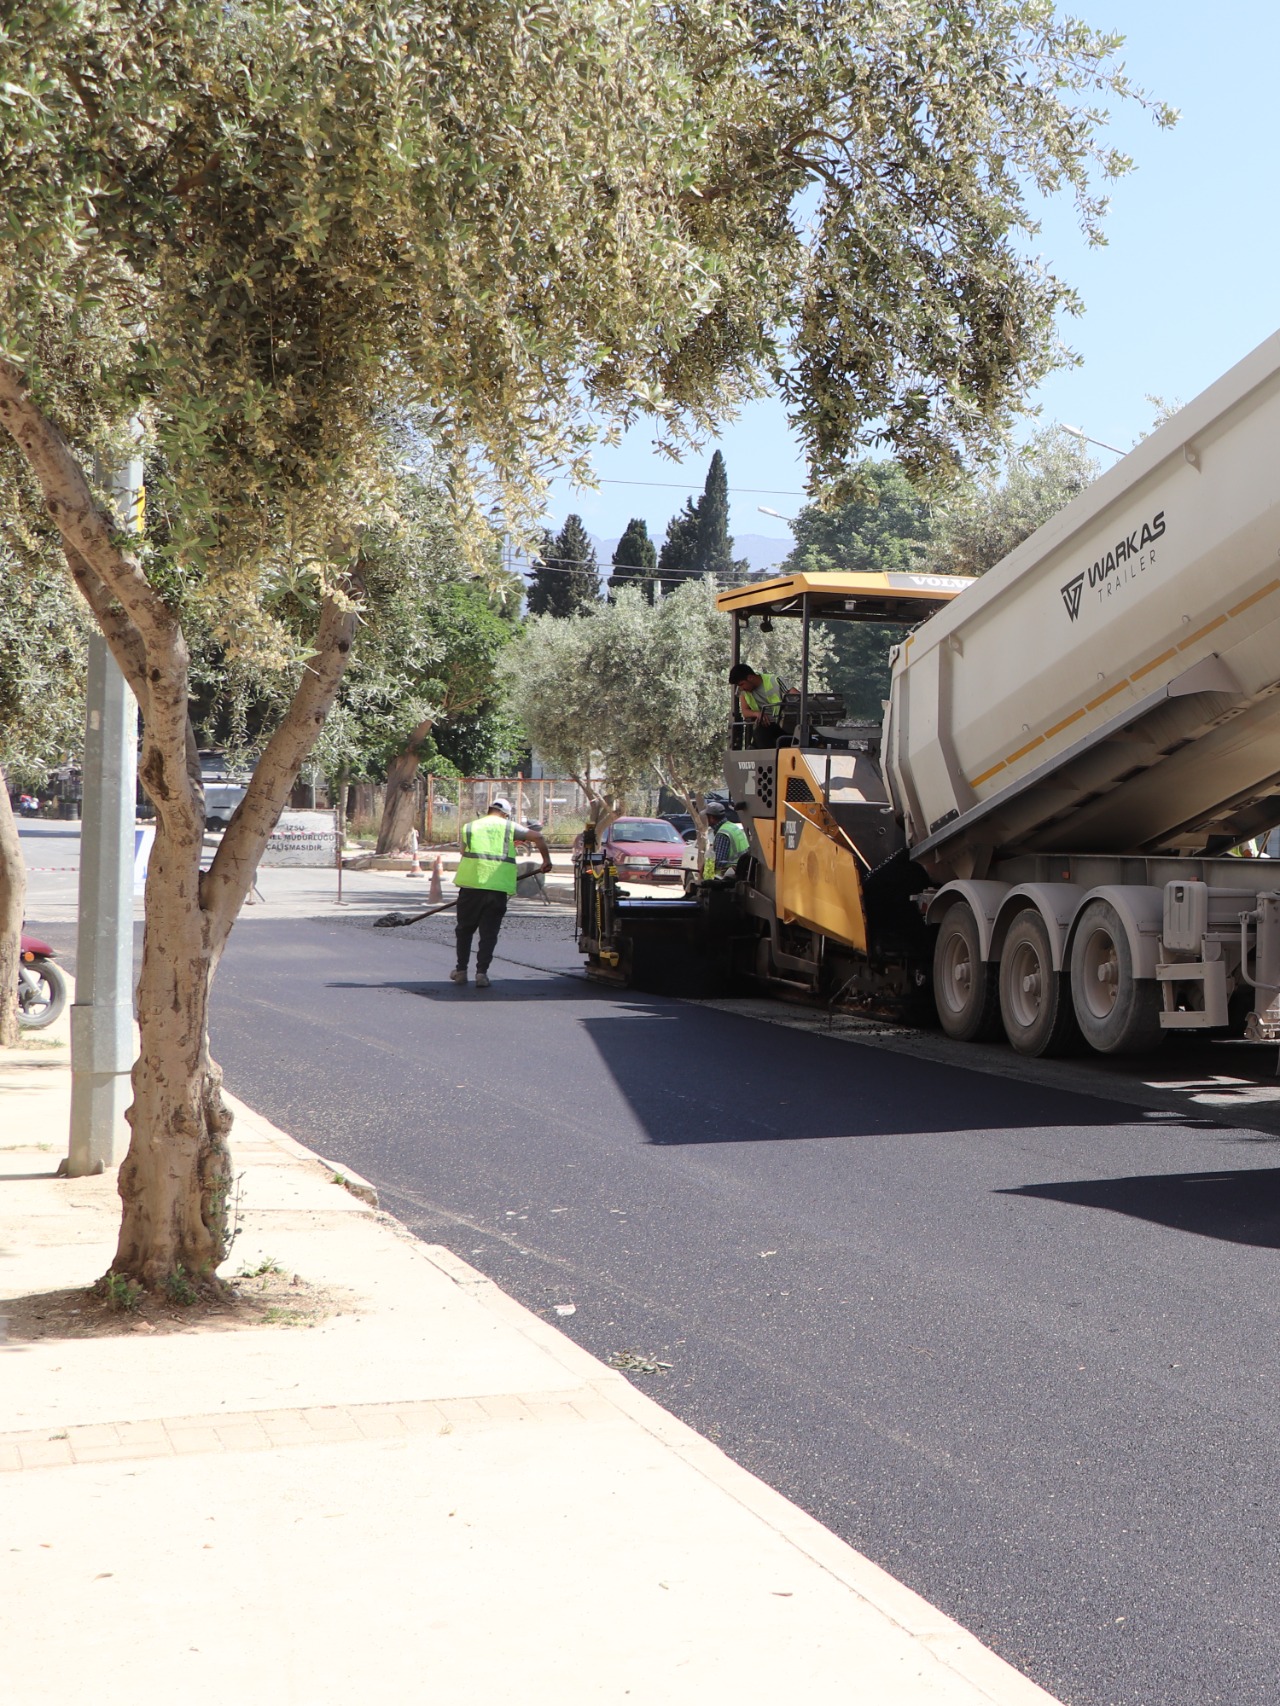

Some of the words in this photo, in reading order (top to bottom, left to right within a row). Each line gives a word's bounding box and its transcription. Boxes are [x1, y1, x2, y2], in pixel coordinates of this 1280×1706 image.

[1087, 510, 1166, 588] WARKAS
[909, 576, 978, 588] VOLV
[1097, 549, 1157, 603] TRAILER
[738, 761, 756, 770] VOLVO
